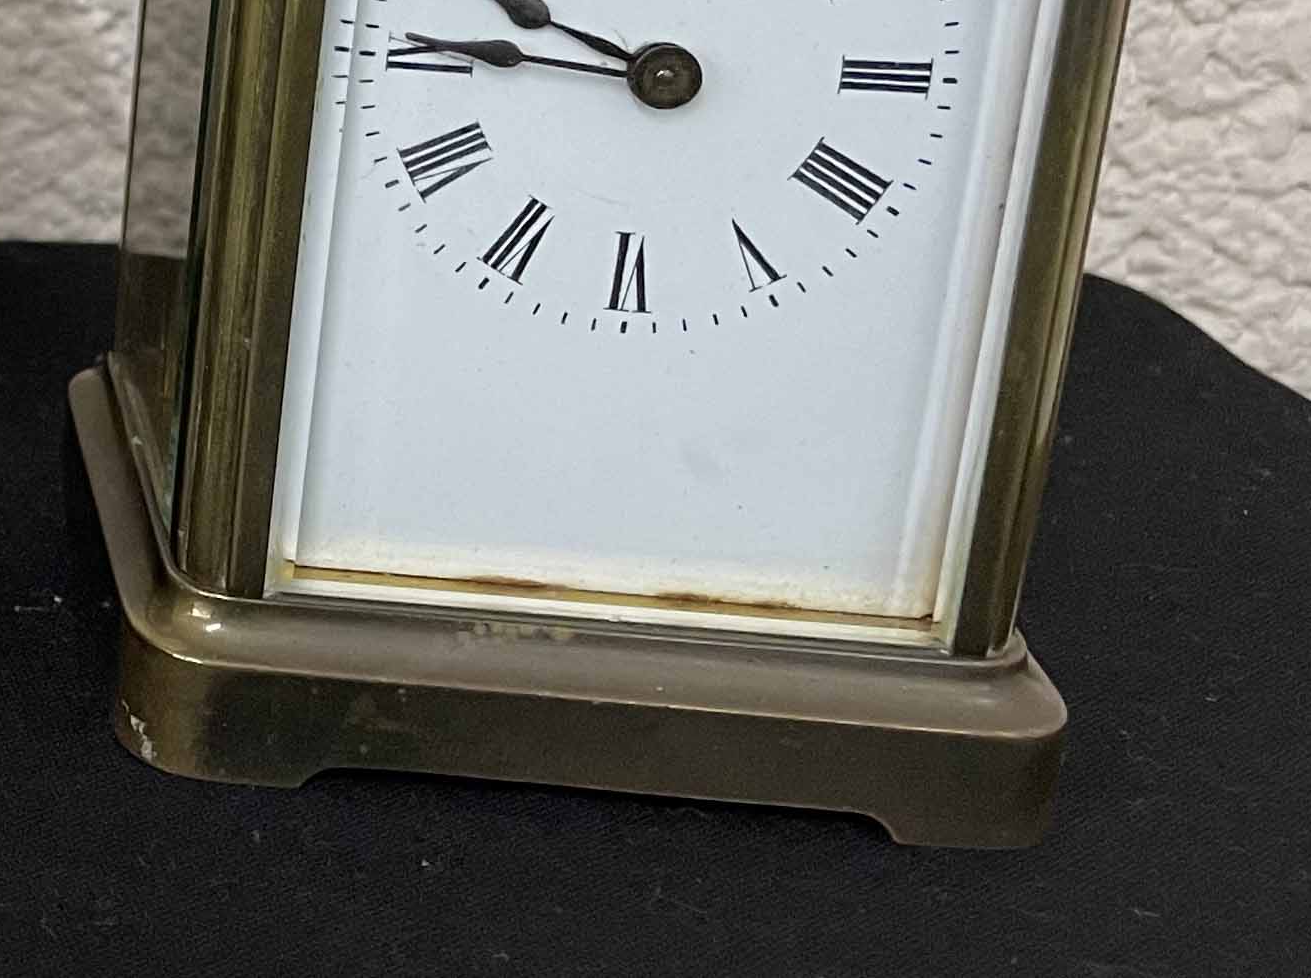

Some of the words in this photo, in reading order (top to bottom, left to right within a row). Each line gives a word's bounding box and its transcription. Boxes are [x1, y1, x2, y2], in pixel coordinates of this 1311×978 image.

[385, 31, 474, 78] IX
[838, 55, 933, 99] III
[396, 120, 493, 203] VIII
[787, 137, 894, 225] IIII
[478, 195, 555, 286] VII
[603, 231, 652, 314] VI
[731, 218, 787, 292] V
